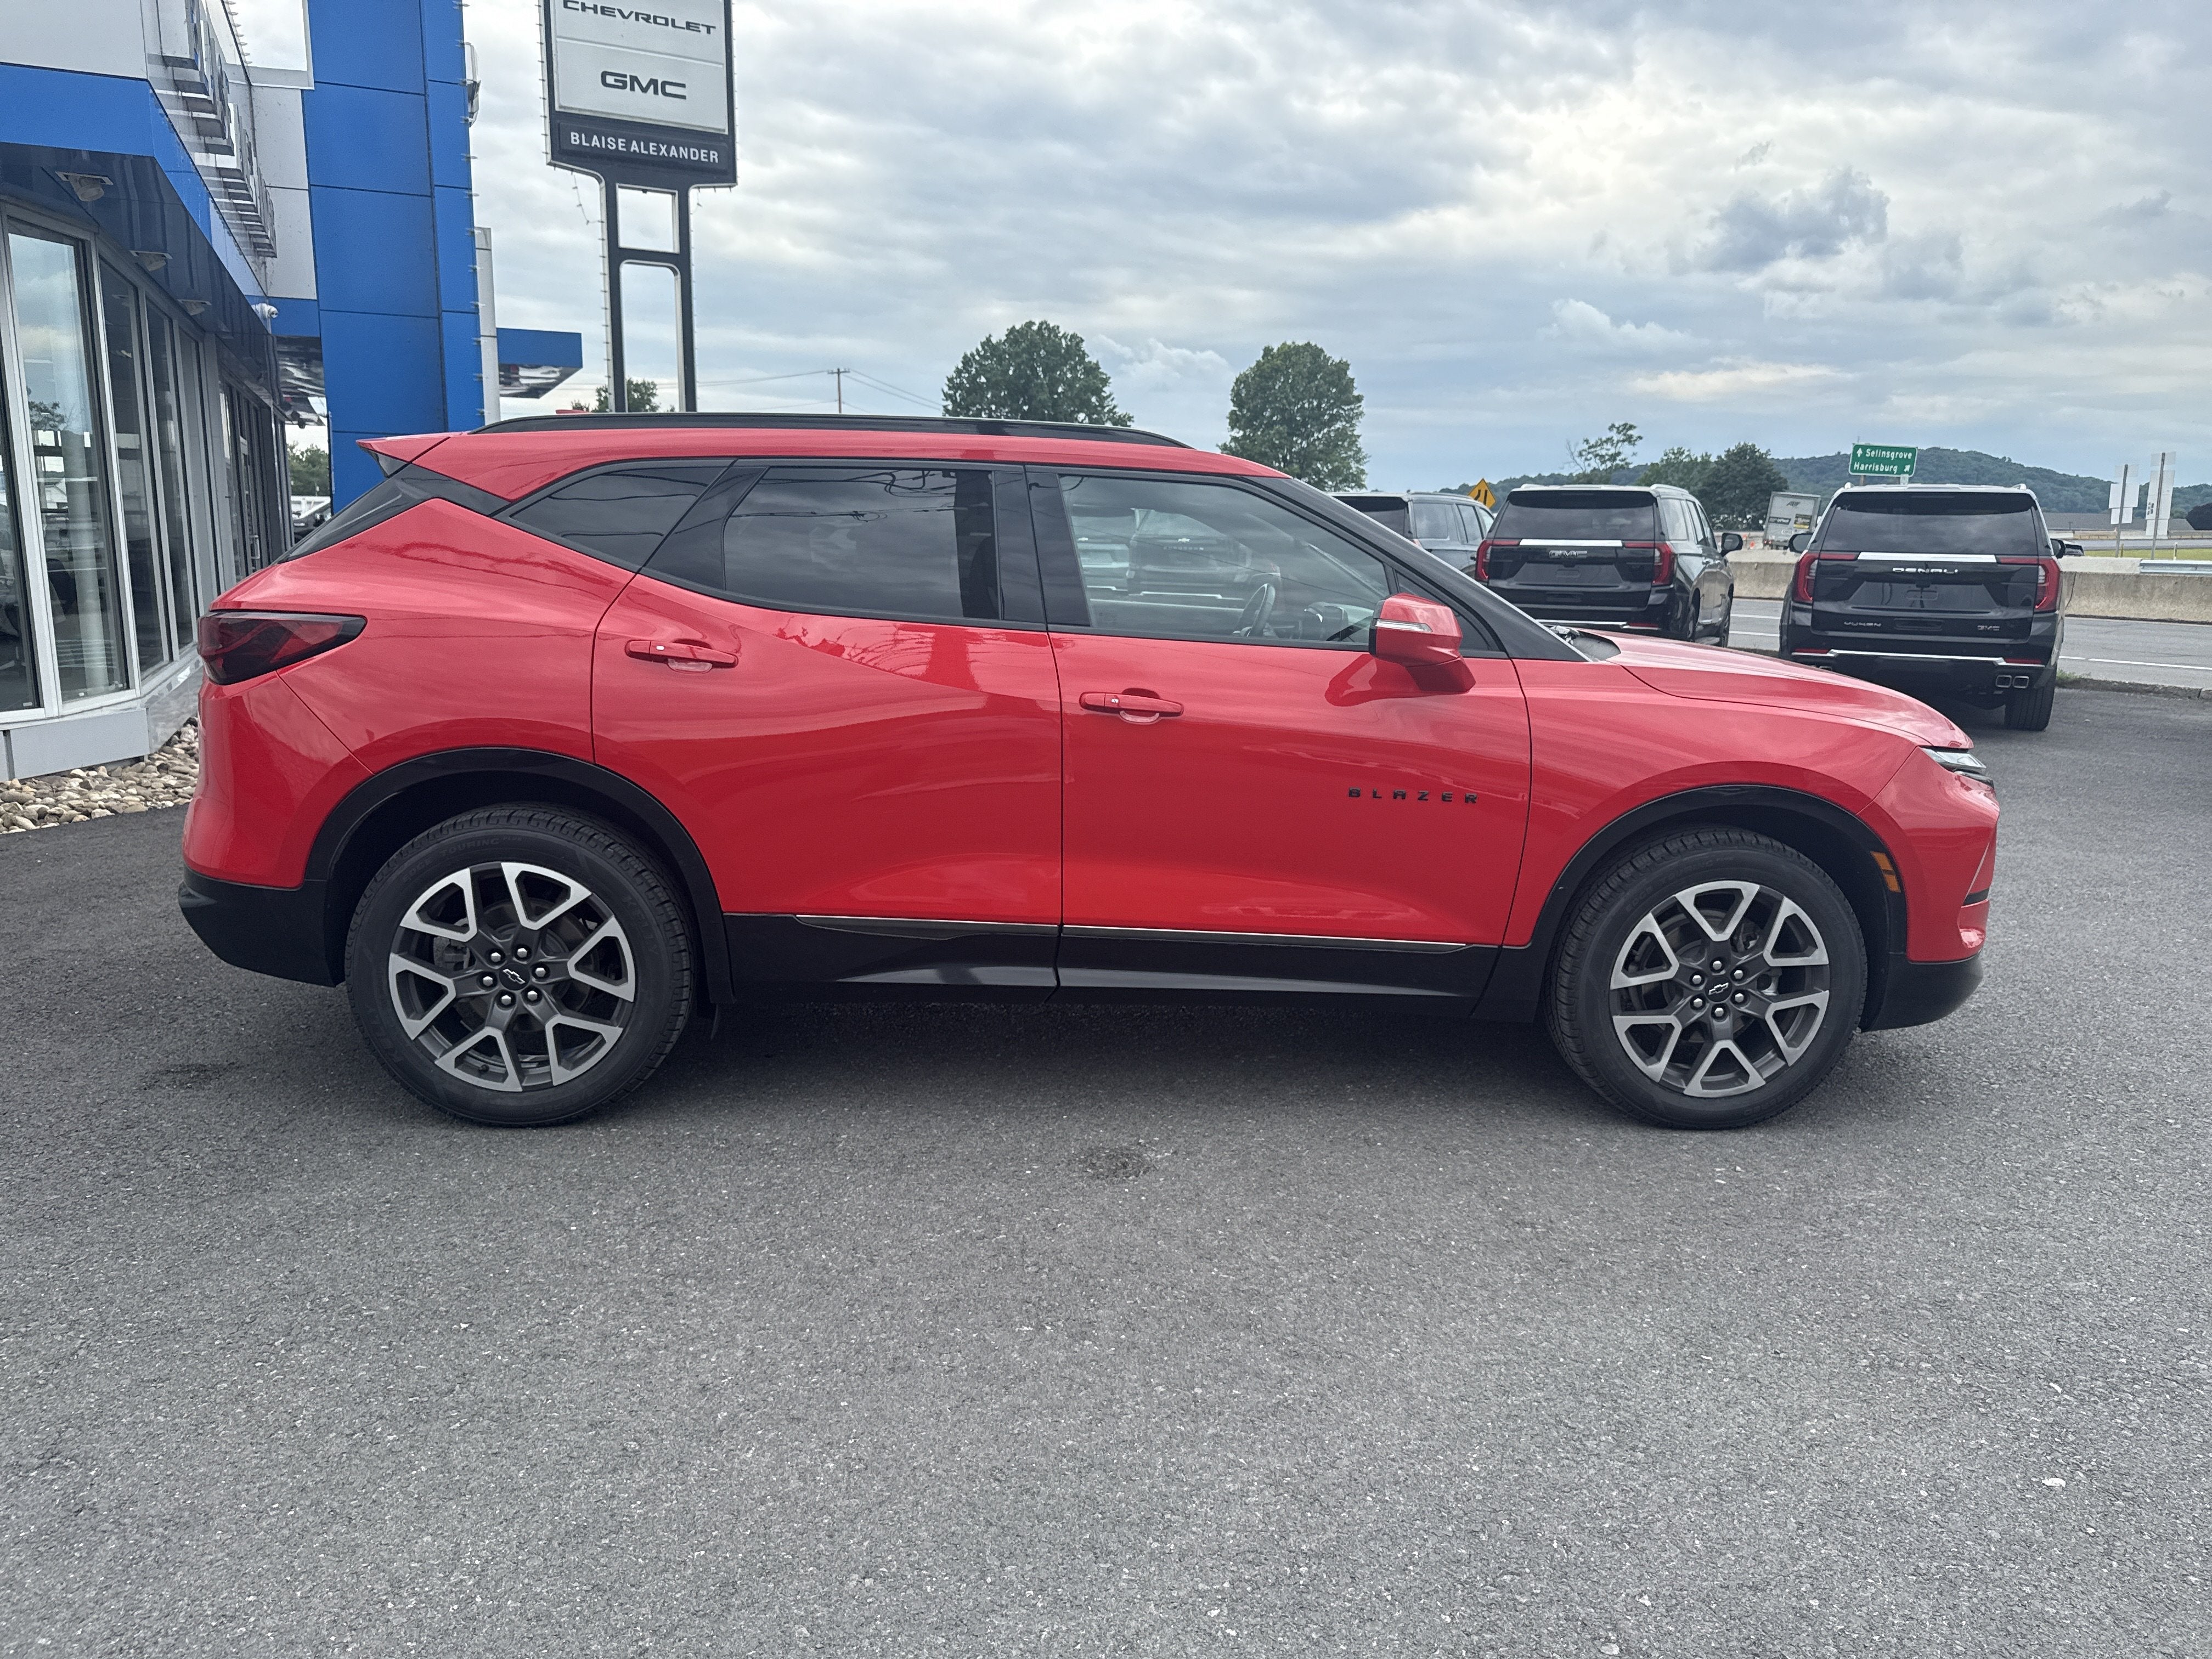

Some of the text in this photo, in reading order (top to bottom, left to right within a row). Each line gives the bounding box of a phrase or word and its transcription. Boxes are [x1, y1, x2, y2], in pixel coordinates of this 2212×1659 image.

[563, 0, 716, 35] CHEVROLET
[600, 70, 687, 100] GMC
[570, 131, 719, 163] BLAISE ALEXANDER
[1865, 448, 1912, 461] Selinsgrove
[1854, 461, 1898, 475] Harrisburg
[1348, 786, 1479, 804] BLAZER
[439, 837, 500, 856] TOURING
